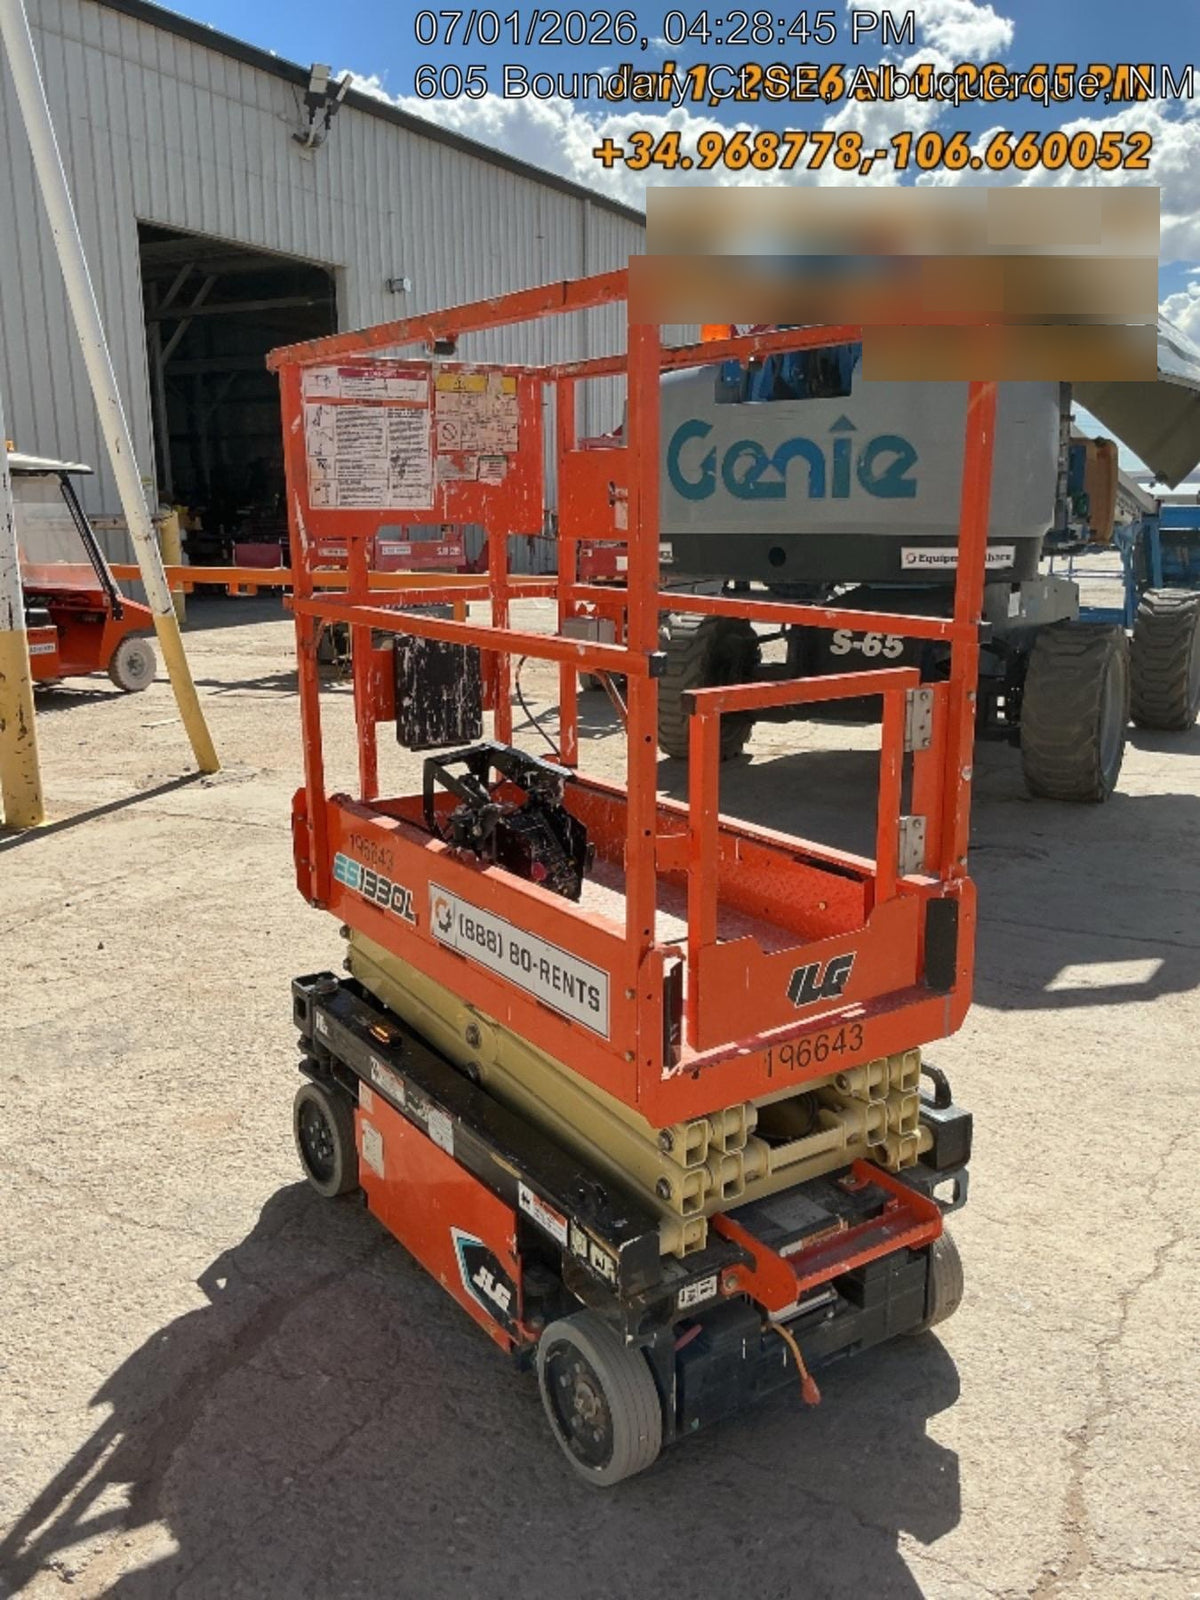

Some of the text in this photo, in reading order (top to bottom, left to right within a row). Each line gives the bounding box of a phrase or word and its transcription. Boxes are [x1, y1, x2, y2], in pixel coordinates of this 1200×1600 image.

[667, 414, 919, 501] Genie
[829, 629, 905, 659] S-65
[333, 852, 417, 925] ES1330L
[458, 913, 601, 1013] (888) 80-RENTS
[764, 1022, 864, 1078] 196643
[472, 1266, 512, 1312] JLG
